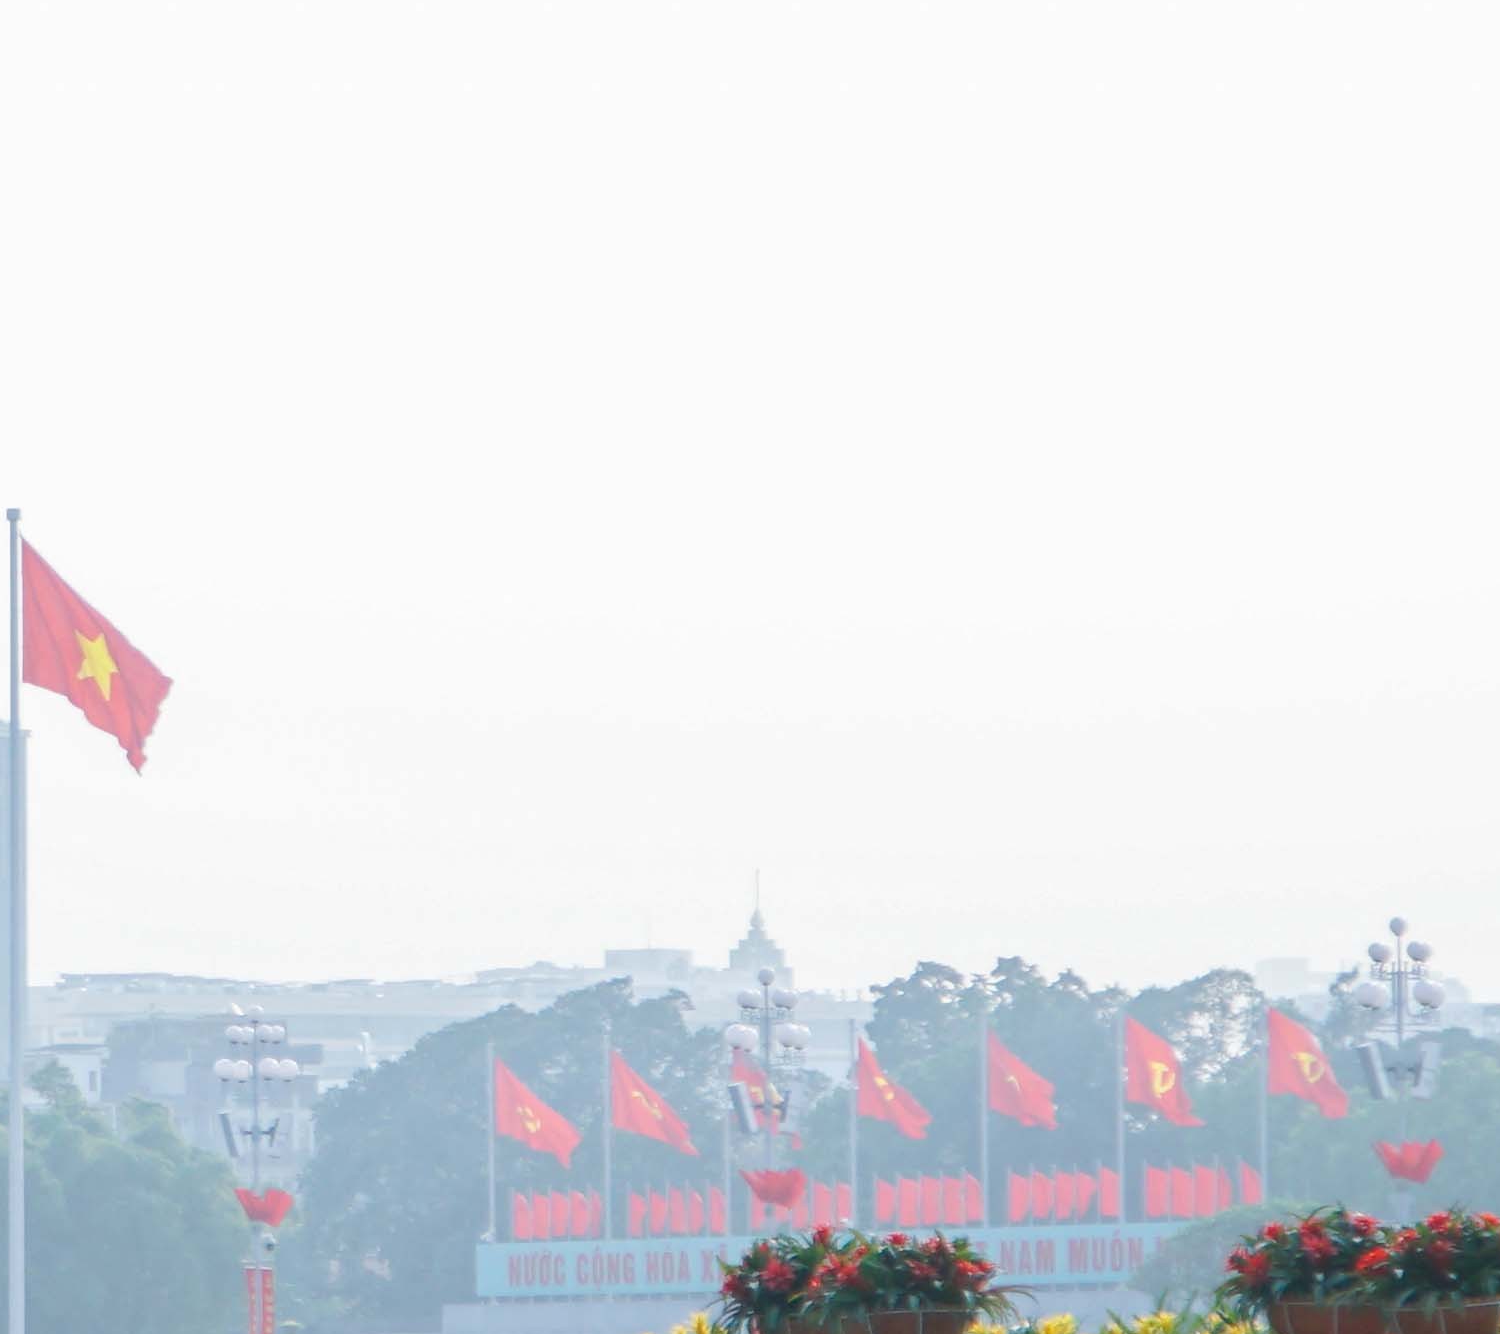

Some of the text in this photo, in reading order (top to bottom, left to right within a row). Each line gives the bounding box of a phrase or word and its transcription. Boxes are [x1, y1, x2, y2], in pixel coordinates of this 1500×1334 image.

[508, 1246, 567, 1288] NƯỚC
[576, 1246, 635, 1291] CỘNG
[1001, 1238, 1056, 1276] NAM
